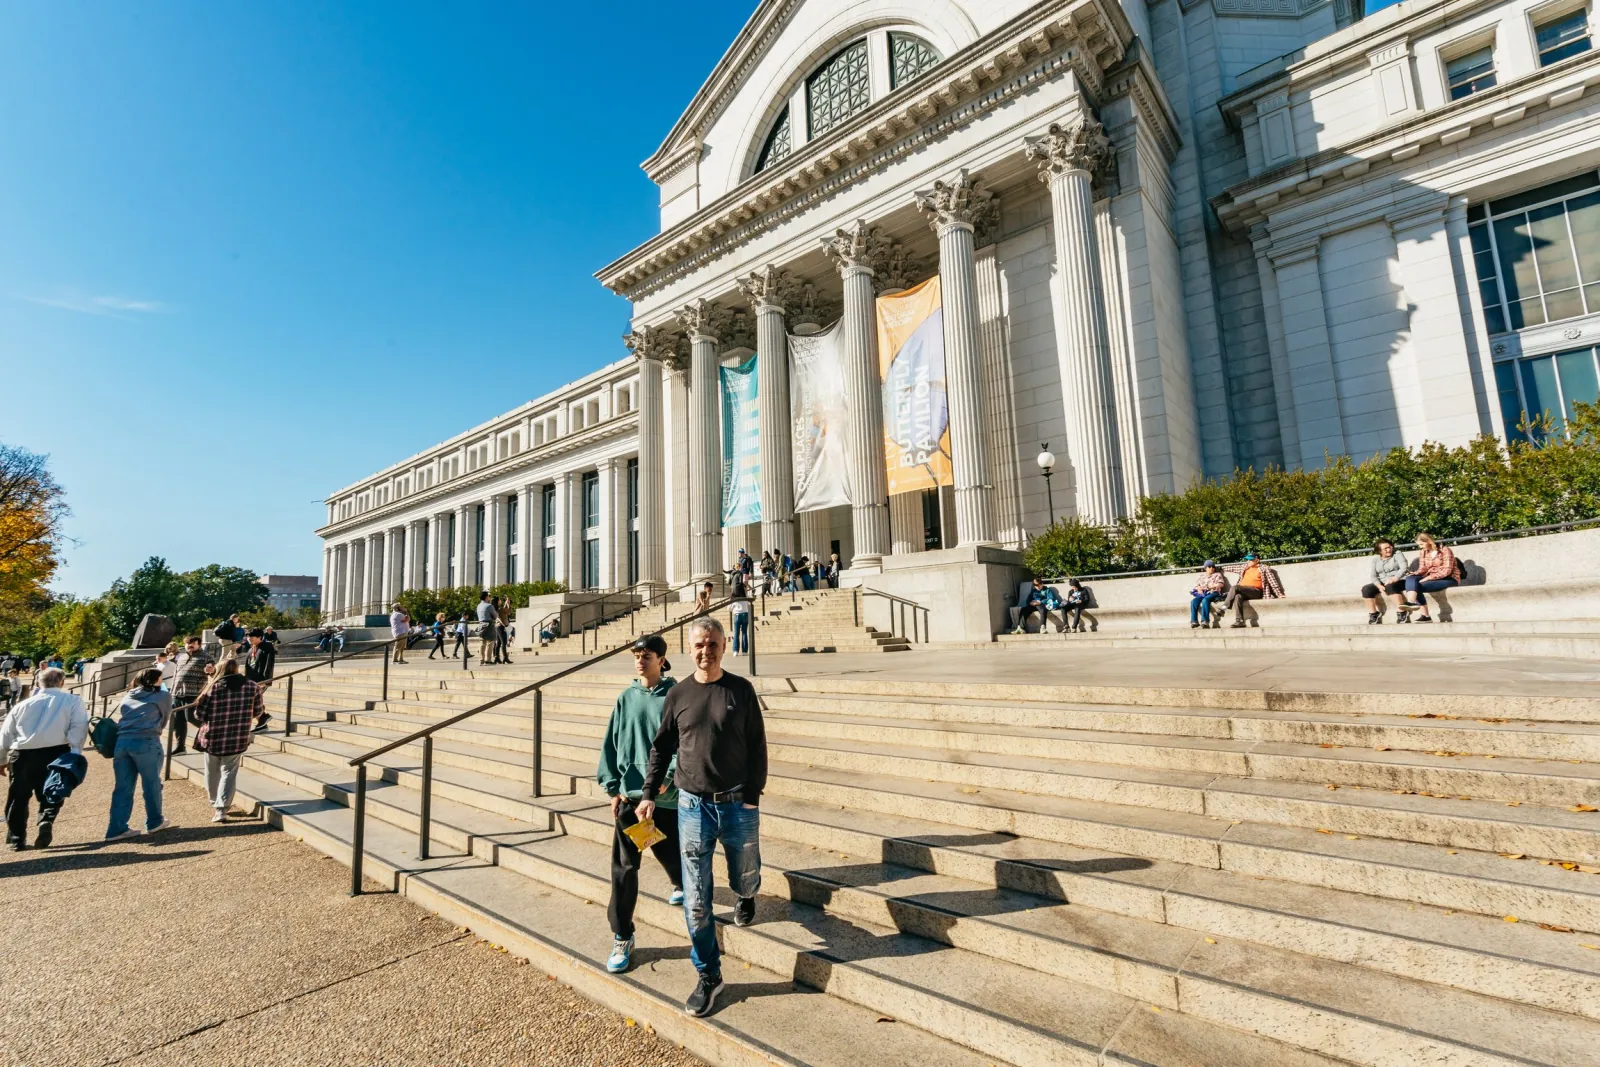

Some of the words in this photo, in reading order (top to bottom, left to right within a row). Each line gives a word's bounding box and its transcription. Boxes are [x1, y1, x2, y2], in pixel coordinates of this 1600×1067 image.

[894, 359, 914, 468] BUTTERFLY
[914, 365, 932, 464] PAVILION
[796, 416, 805, 462] PLACES
[723, 458, 732, 508] GENOME
[796, 464, 806, 492] OUR
